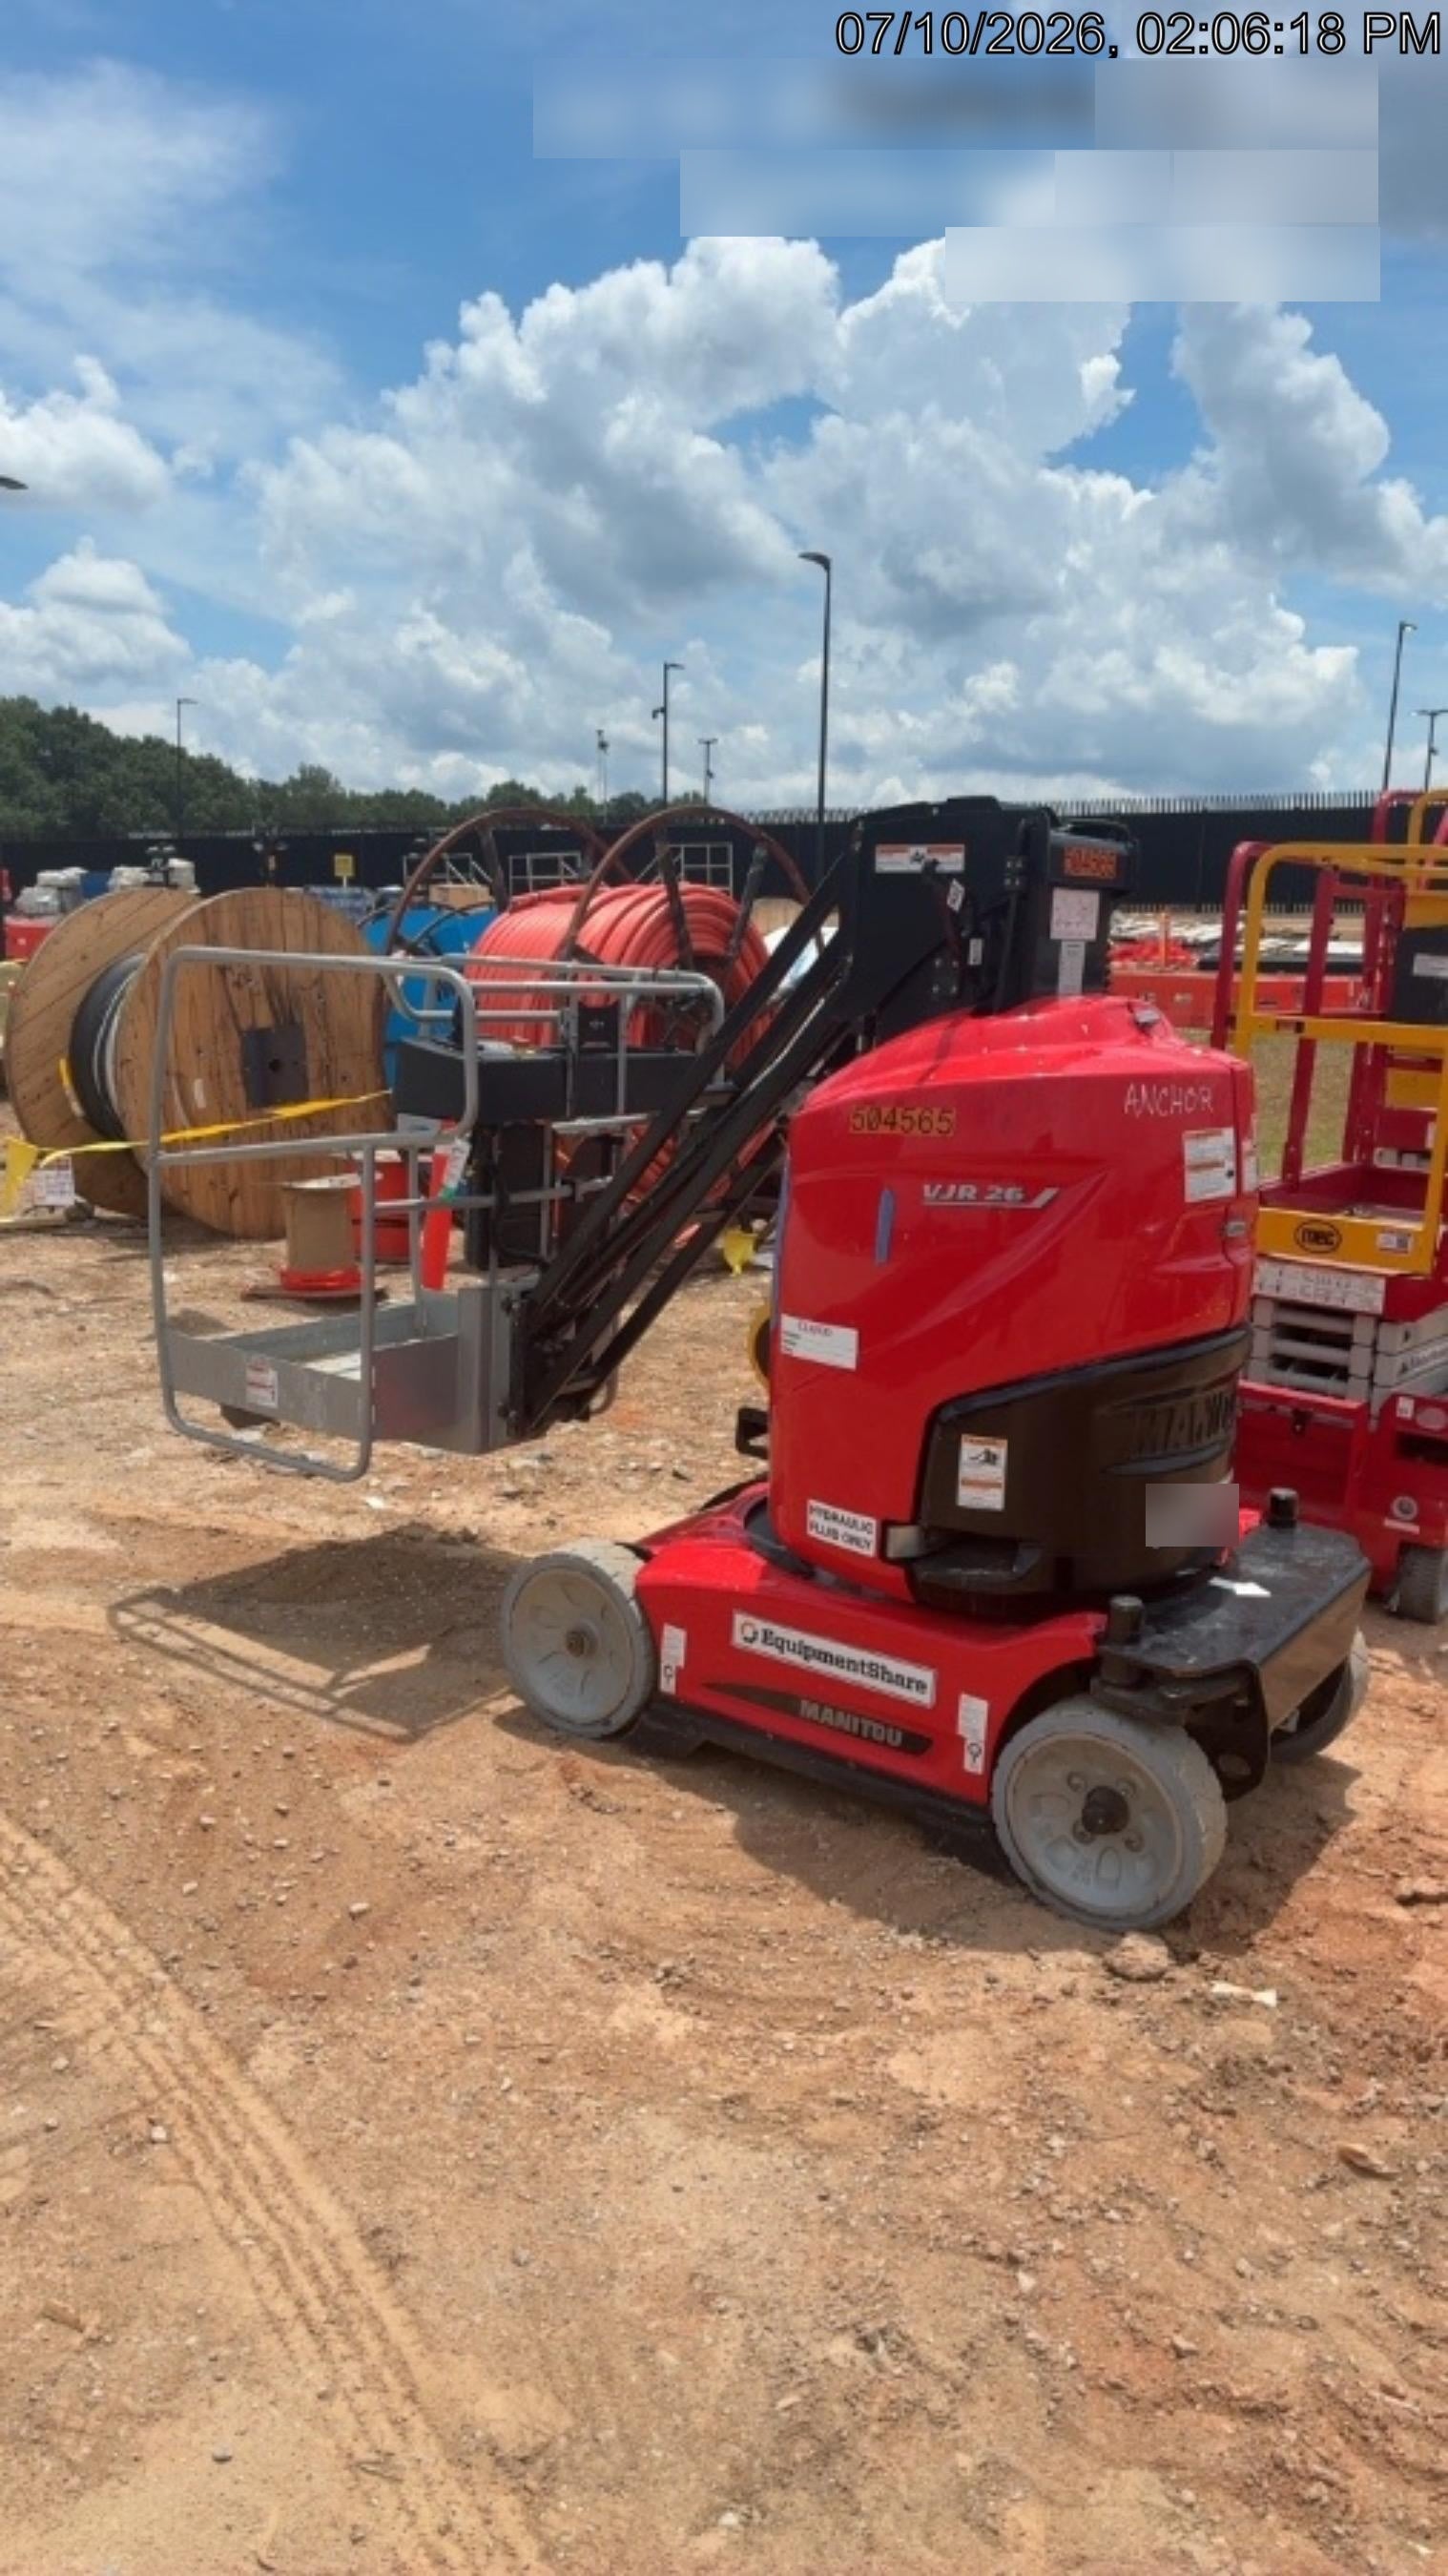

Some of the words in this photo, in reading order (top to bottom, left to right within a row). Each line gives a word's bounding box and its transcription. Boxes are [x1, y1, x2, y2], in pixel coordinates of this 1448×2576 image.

[1124, 1083, 1214, 1118] ANCHOR
[850, 1107, 955, 1134] 504565
[922, 1184, 978, 1201] VJR
[983, 1185, 1025, 1202] 26
[809, 1506, 872, 1534] HYDRAULIC
[760, 1627, 929, 1695] EquipmentShare
[799, 1699, 903, 1748] MANITOU
